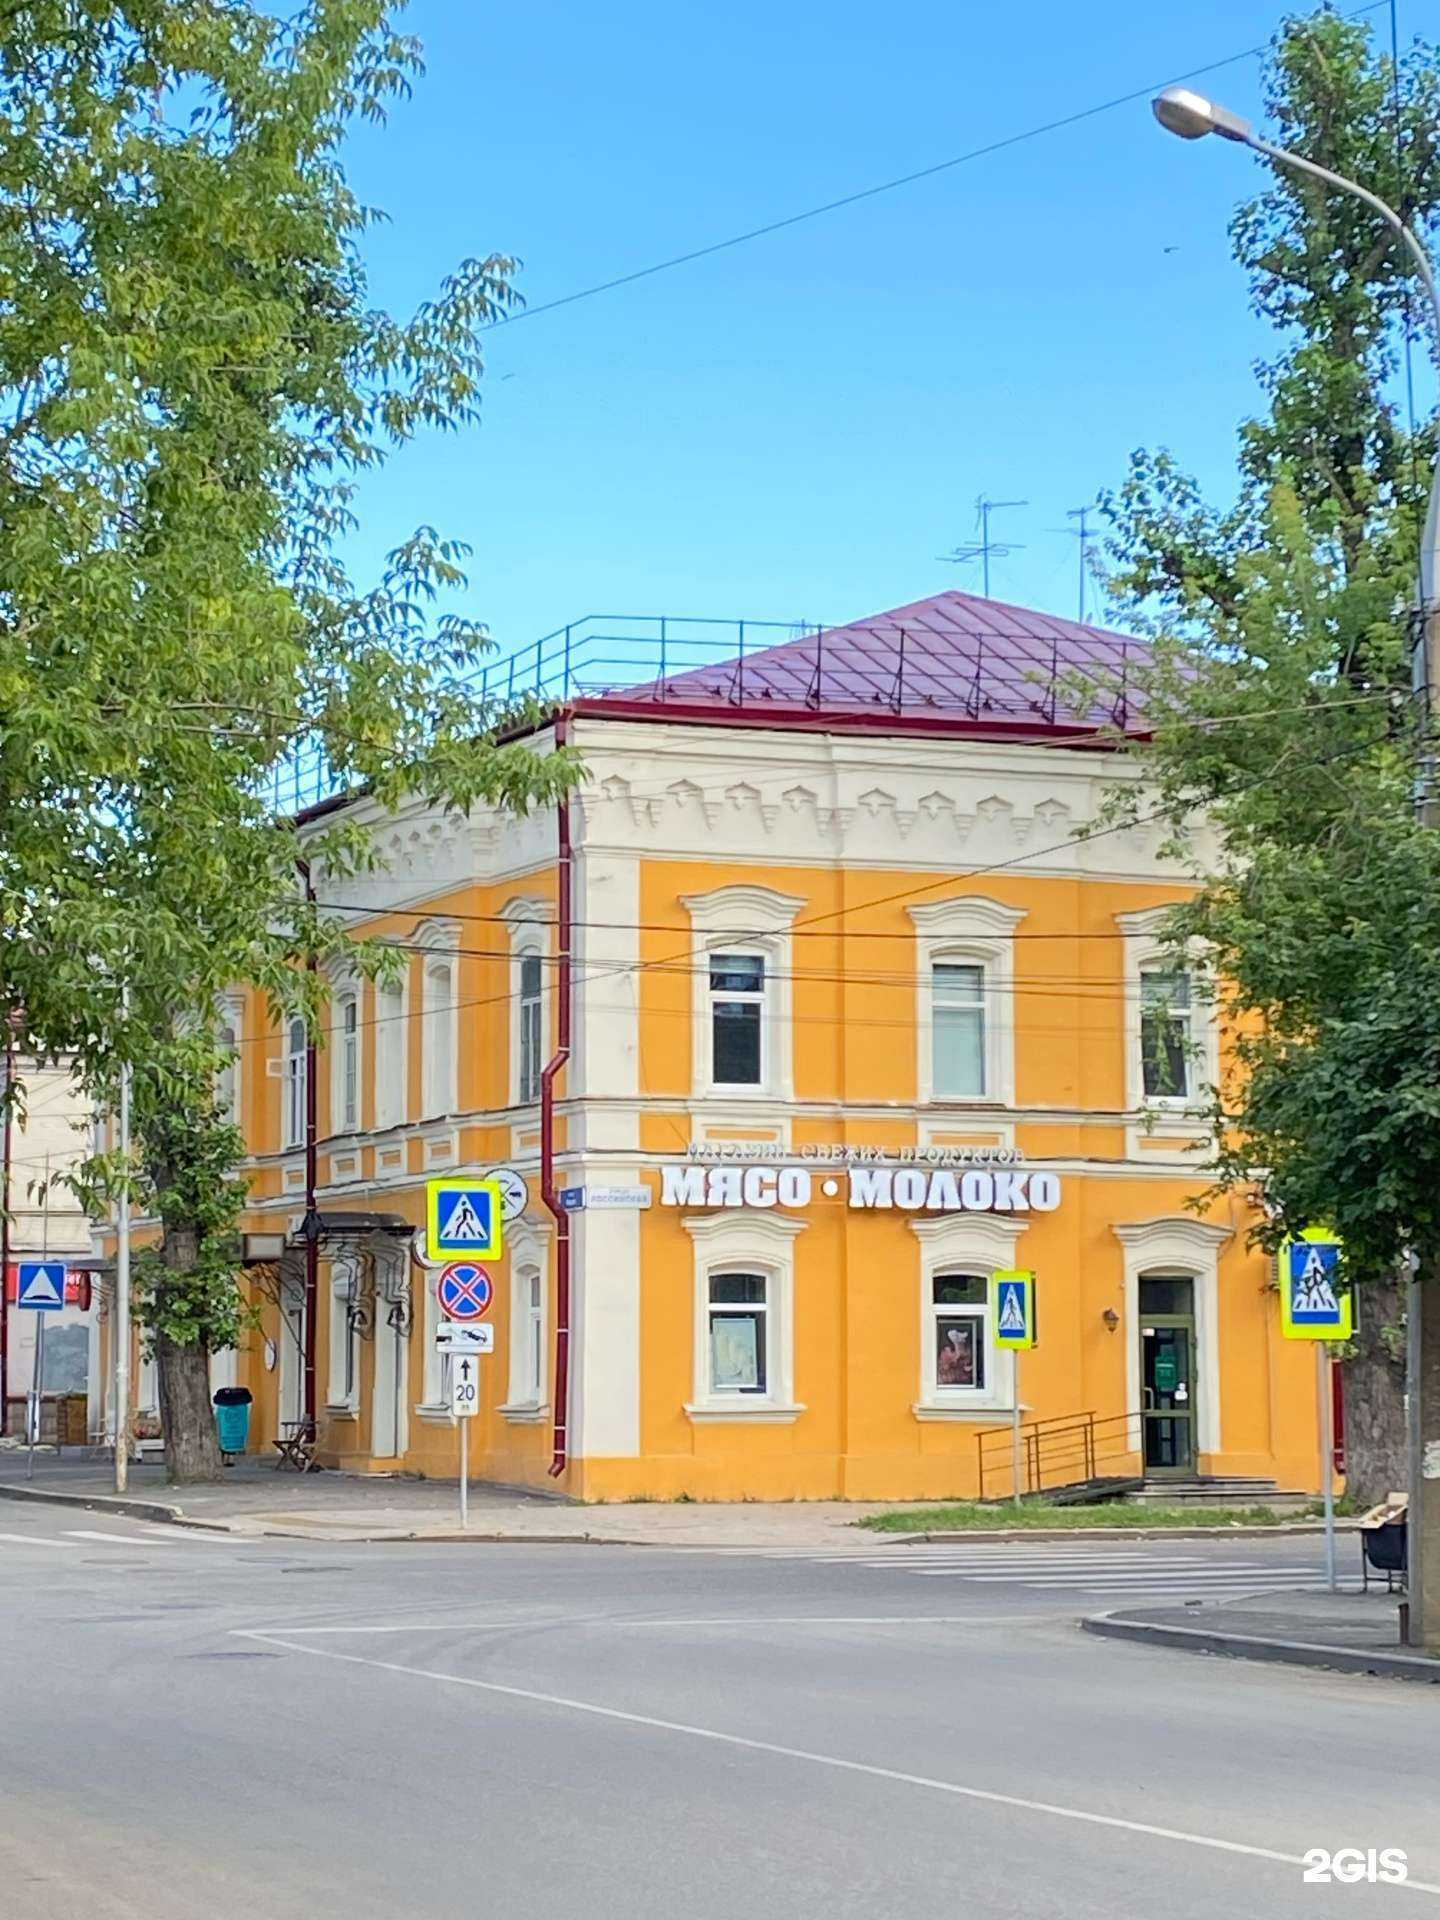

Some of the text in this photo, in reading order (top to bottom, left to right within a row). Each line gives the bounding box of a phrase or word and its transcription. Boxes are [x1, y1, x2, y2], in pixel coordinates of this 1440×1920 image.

[800, 1143, 885, 1161] СВЕЖИХ
[661, 1166, 1061, 1212] МЯСО МОЛОКО
[456, 1384, 475, 1401] 20
